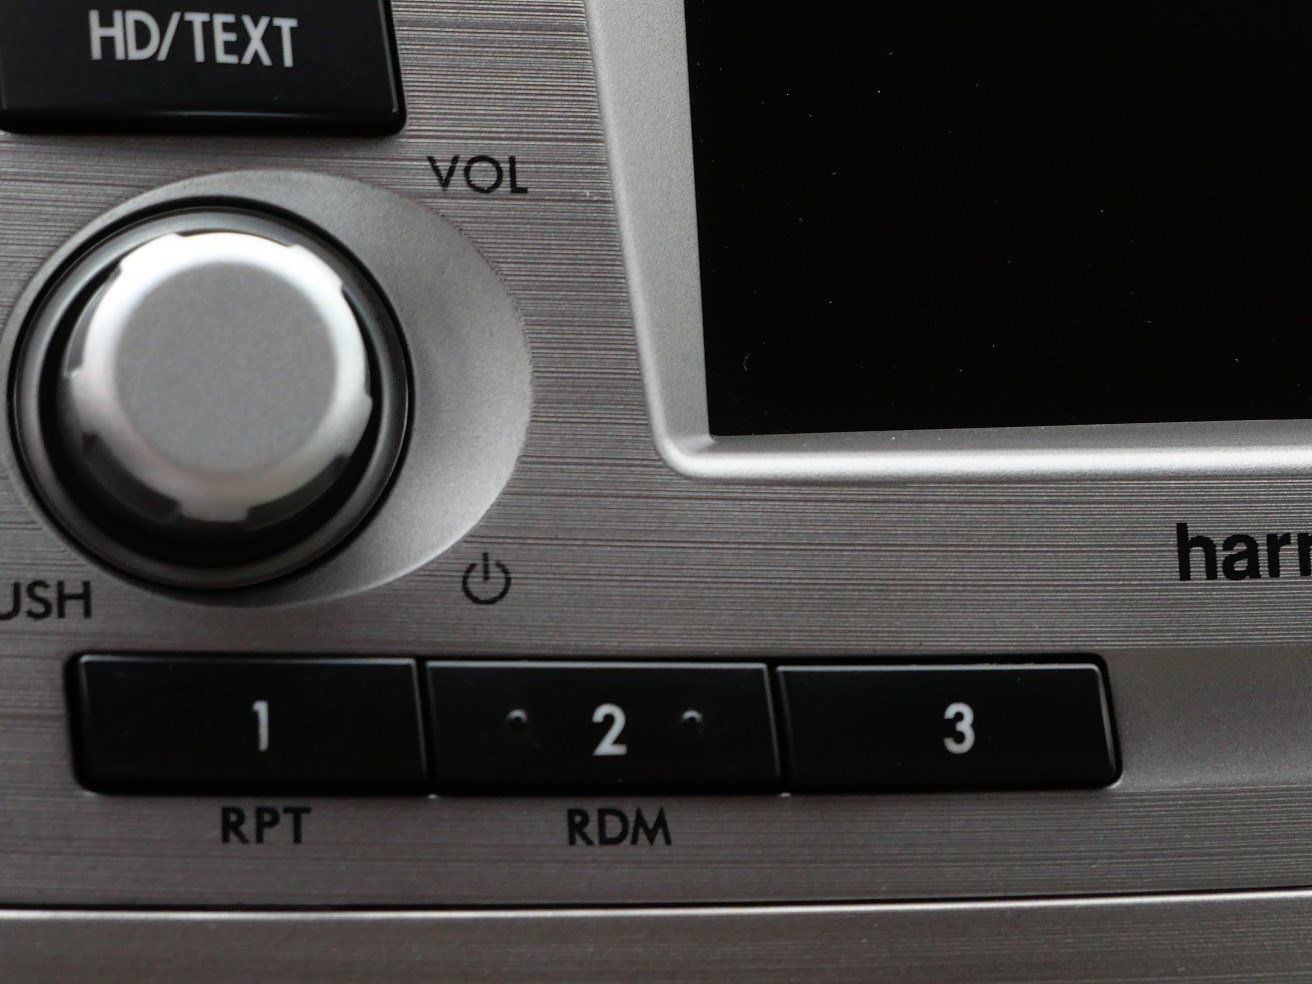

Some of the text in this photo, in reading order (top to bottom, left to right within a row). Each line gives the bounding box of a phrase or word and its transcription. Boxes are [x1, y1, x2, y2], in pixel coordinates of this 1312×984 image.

[88, 9, 298, 68] HD/TEXT
[426, 154, 529, 195] VOL
[252, 700, 270, 751] 1
[591, 703, 627, 756] 2
[943, 702, 976, 754] 3
[220, 808, 311, 844] RPT
[567, 808, 672, 846] RDM
